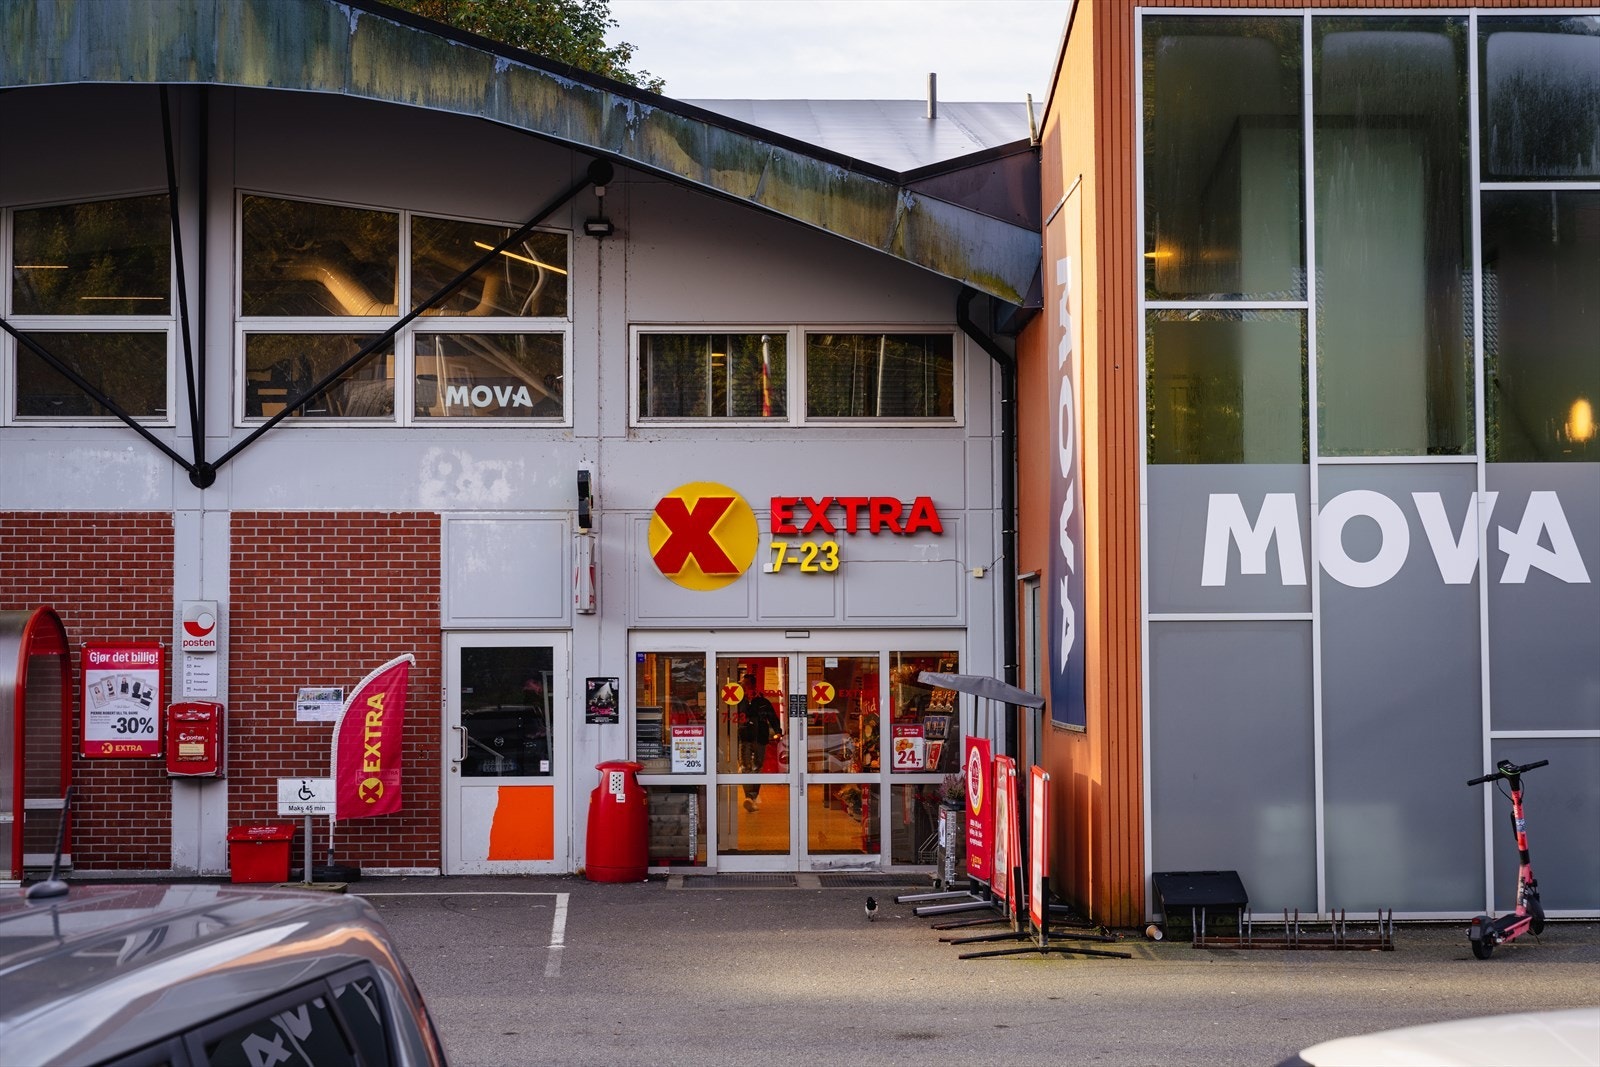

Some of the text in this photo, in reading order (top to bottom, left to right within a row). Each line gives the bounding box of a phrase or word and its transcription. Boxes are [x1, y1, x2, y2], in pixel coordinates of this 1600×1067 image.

[445, 384, 533, 408] MOVA
[1056, 256, 1074, 675] MOVA
[770, 496, 944, 535] EXTRA
[1201, 489, 1592, 588] MOVA
[771, 541, 840, 573] 7-23
[182, 638, 215, 648] posten
[89, 652, 159, 664] Gjør det billig!
[110, 717, 154, 734] -30%
[722, 713, 747, 724] 7-23
[363, 692, 385, 773] EXTRA
[115, 744, 142, 752] EXTRA
[684, 760, 702, 768] -20%
[898, 751, 922, 767] 24,-
